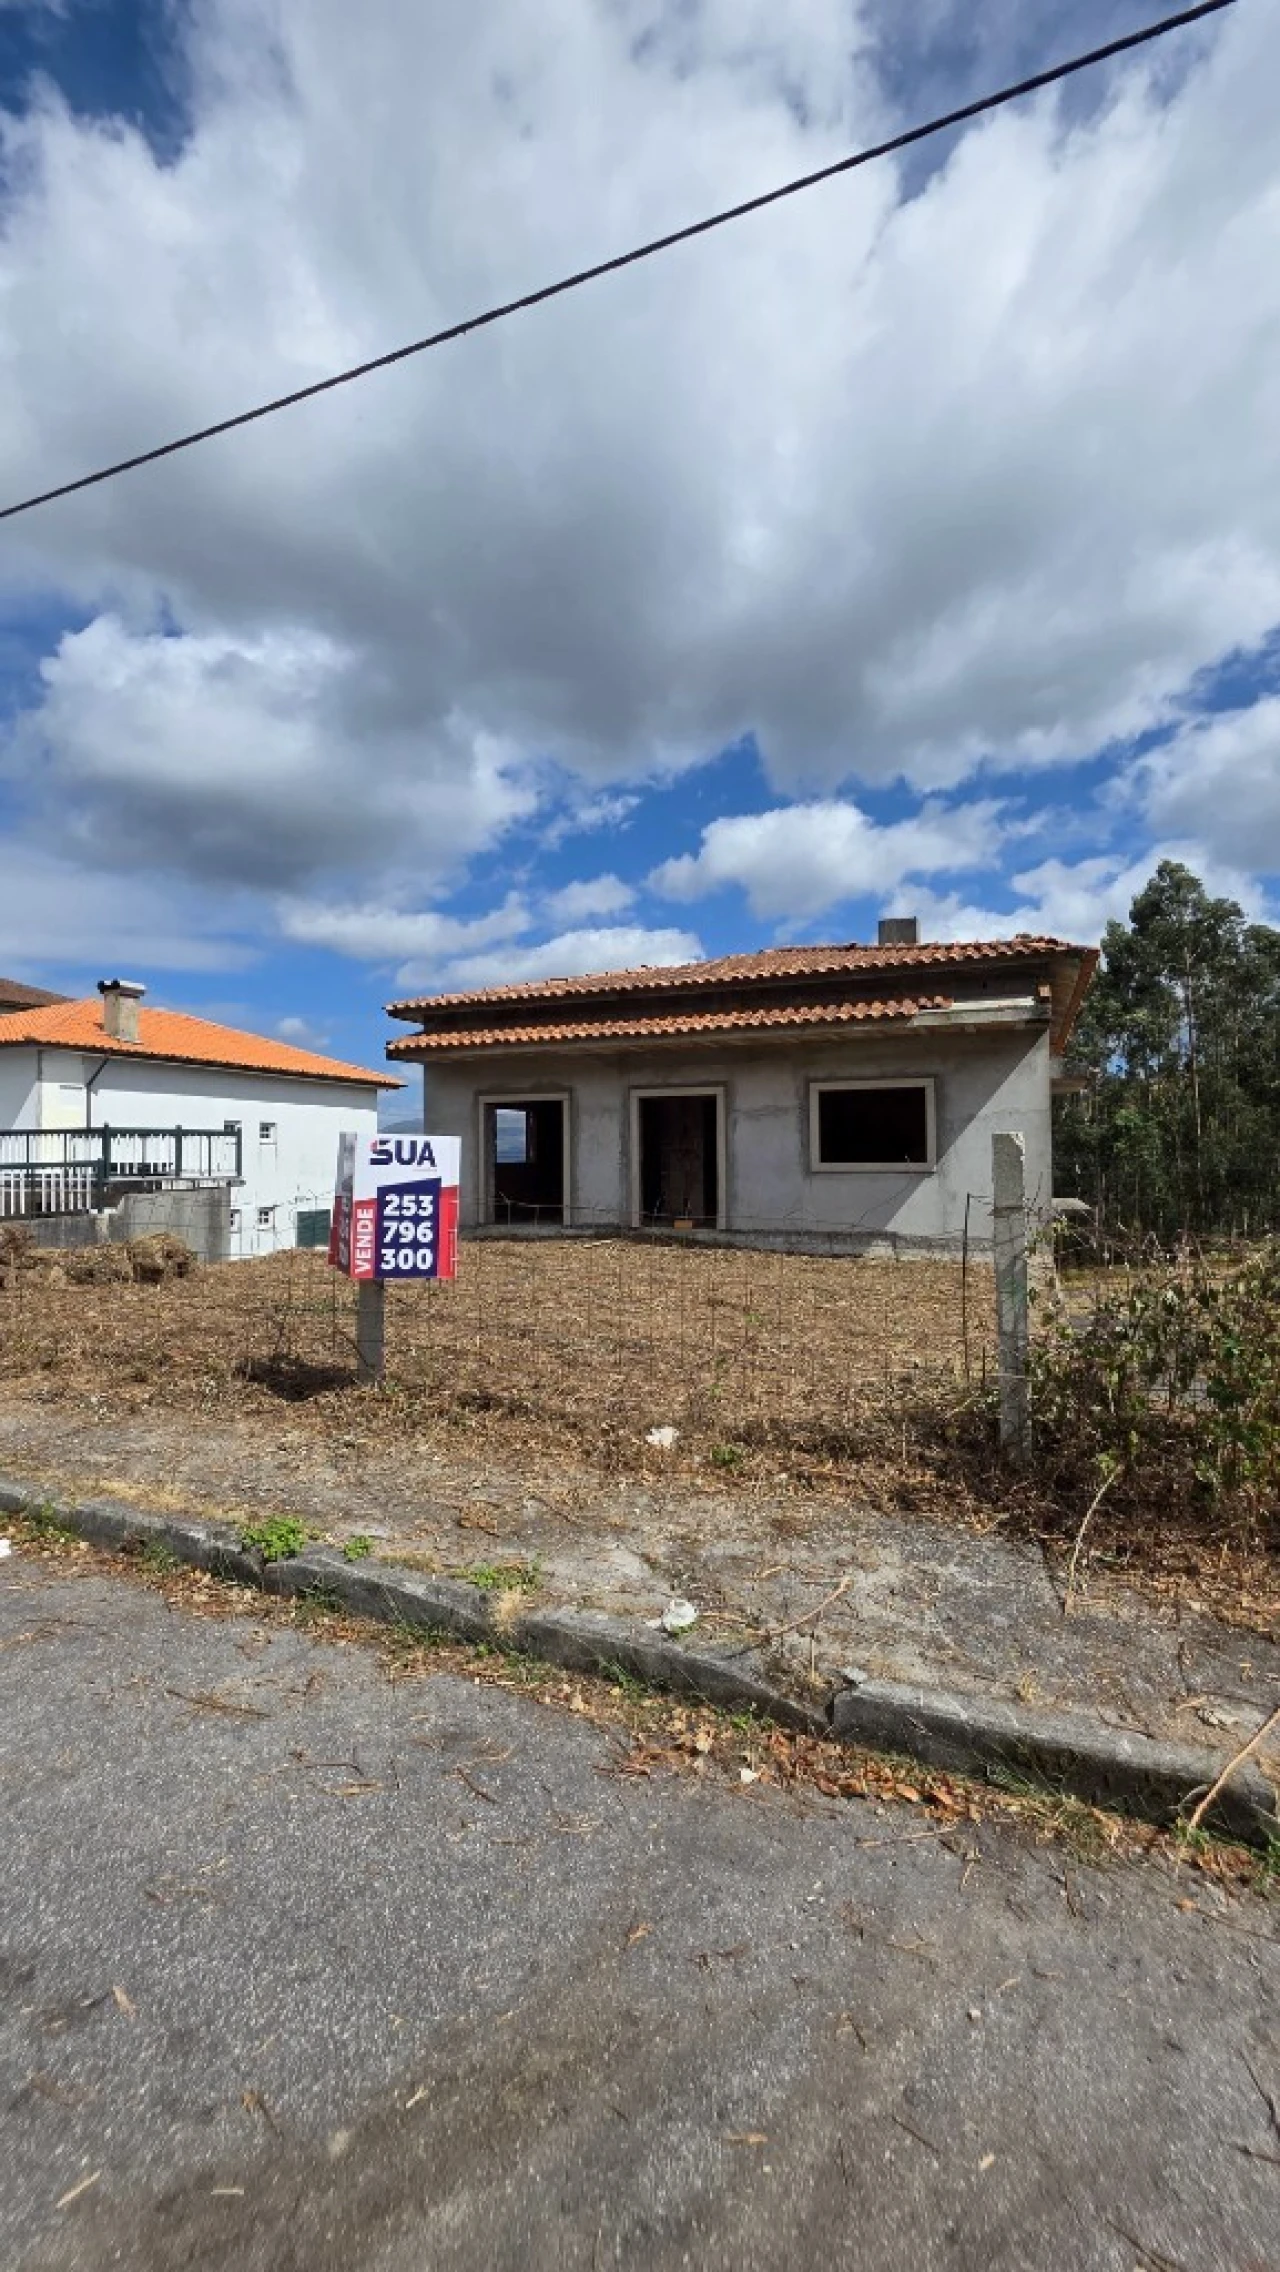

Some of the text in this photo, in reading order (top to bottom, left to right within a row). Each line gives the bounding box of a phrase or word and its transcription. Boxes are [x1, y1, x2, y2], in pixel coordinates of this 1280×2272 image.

[370, 1138, 437, 1167] SUA
[384, 1194, 433, 1216] 253
[355, 1208, 374, 1274] VENDE
[383, 1220, 433, 1243] 796
[381, 1248, 433, 1270] 300
